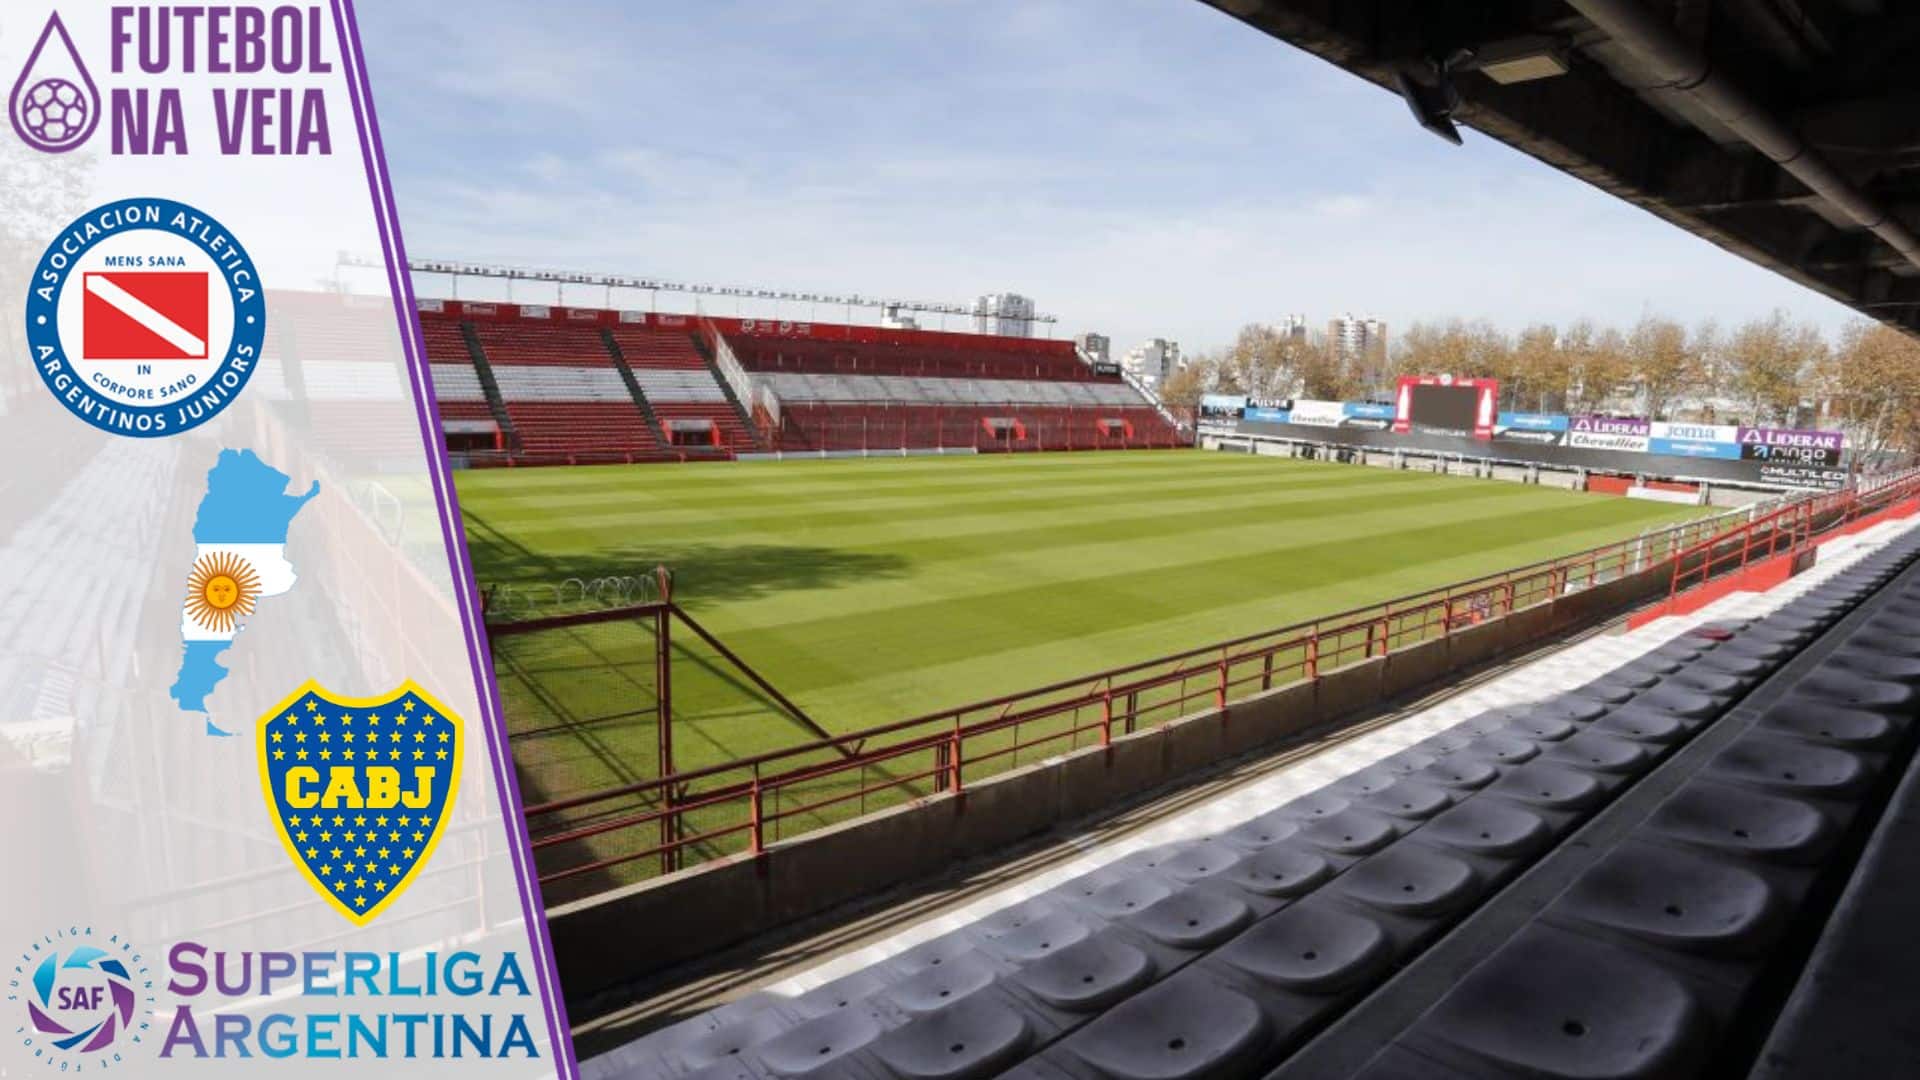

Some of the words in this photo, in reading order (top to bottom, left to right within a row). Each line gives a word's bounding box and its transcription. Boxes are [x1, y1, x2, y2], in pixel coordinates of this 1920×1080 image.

[1574, 434, 1645, 449] Chevallier
[1766, 432, 1836, 448] LIDERAR
[1771, 446, 1827, 463] ringo
